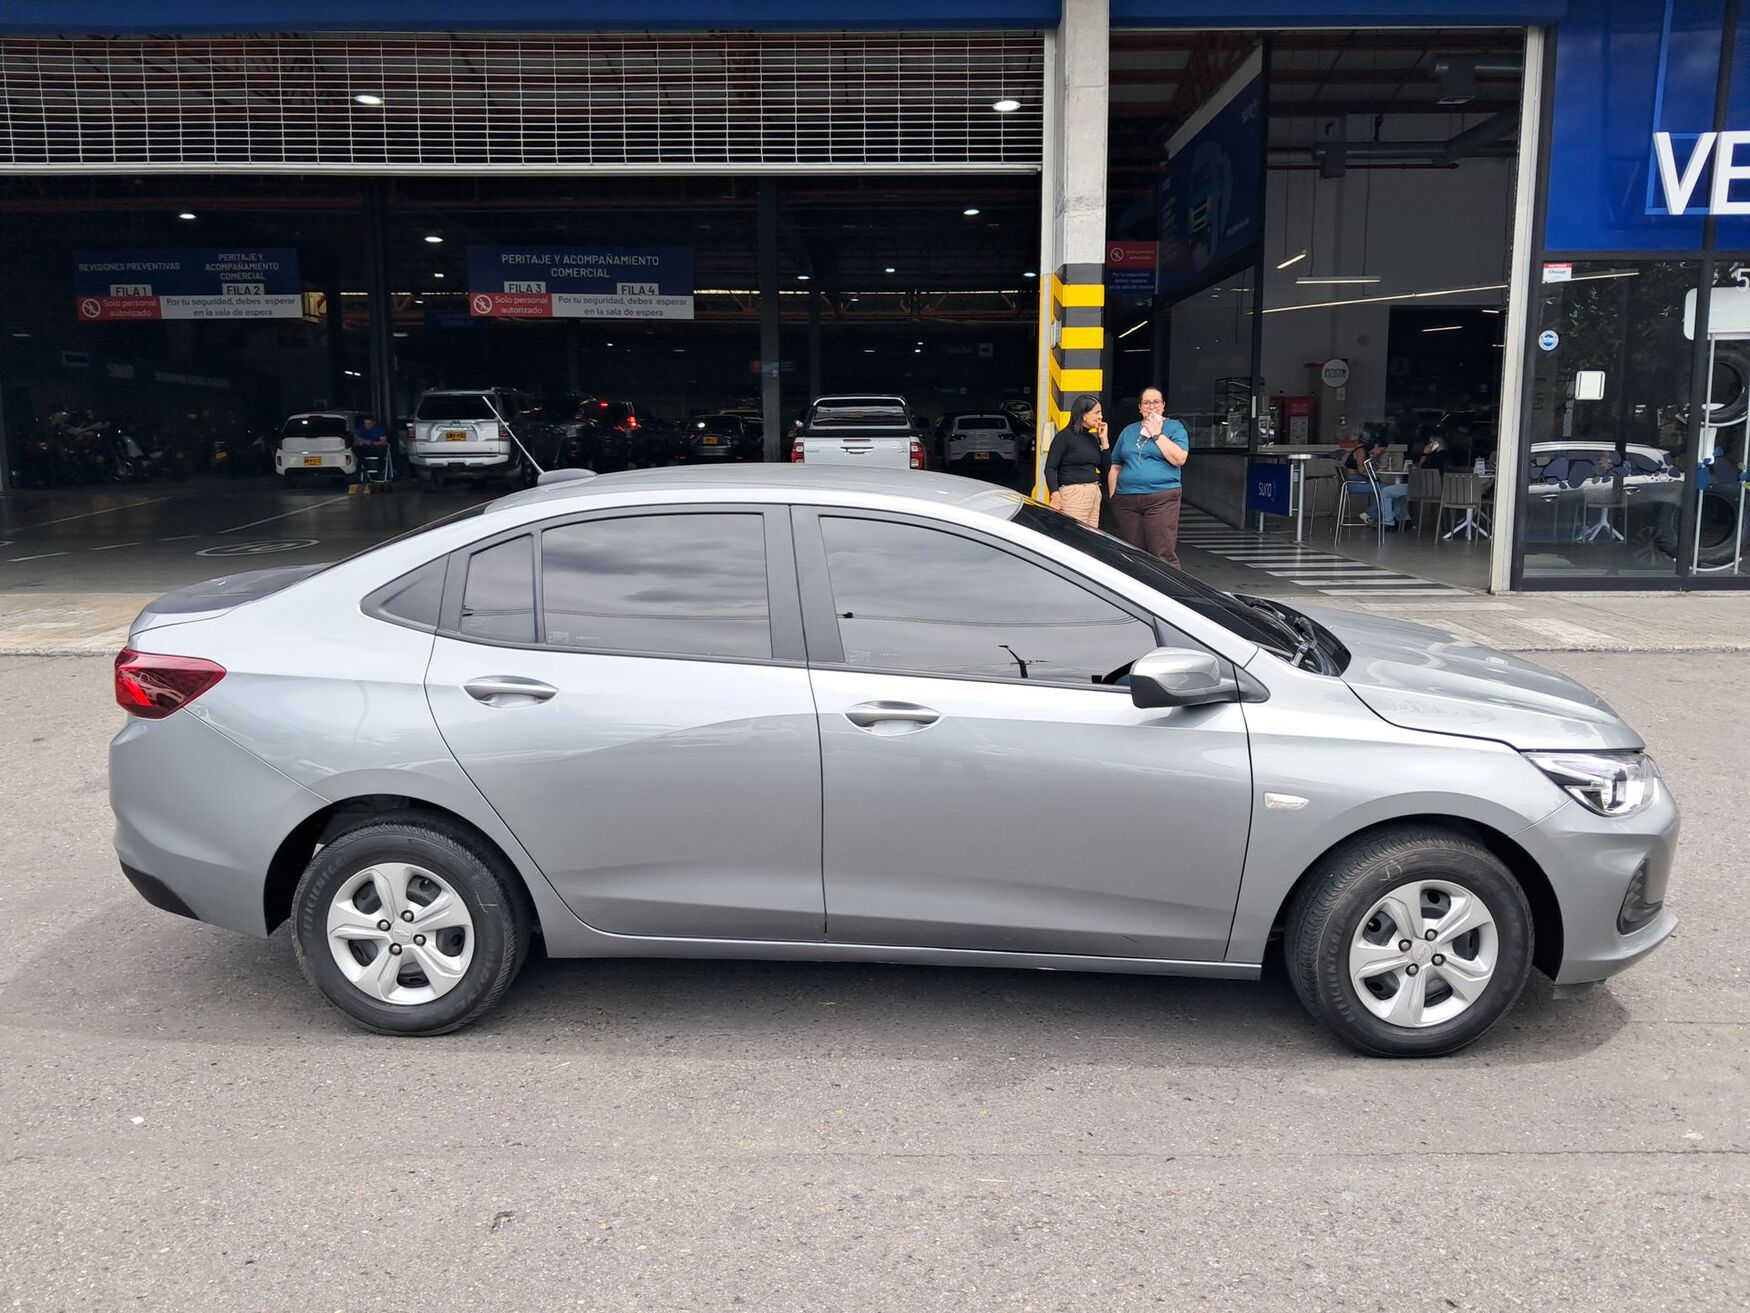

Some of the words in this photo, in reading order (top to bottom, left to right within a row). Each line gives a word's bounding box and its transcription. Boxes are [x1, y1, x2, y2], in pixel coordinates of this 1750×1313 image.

[1652, 130, 1750, 215] VE
[218, 253, 256, 262] PERITAJE
[258, 253, 263, 261] Y
[501, 254, 552, 264] PERITAJE
[554, 254, 561, 264] Y
[563, 253, 659, 266] ACOMPAÑAMIENTO
[79, 263, 125, 272] REVISIONES
[126, 262, 180, 271] PREVENTIVAS
[205, 261, 279, 271] ACOMPAÑAMIENTO
[220, 272, 266, 280] COMERCIAL
[551, 268, 611, 278] COMERCIAL
[116, 287, 140, 296] FILA
[227, 286, 251, 295] FILA
[254, 286, 260, 295] 2
[508, 284, 533, 293] FILA
[536, 284, 542, 293] 3
[621, 285, 647, 295] FILA
[648, 286, 655, 295] 4
[514, 296, 549, 304] personal
[558, 296, 572, 304] Por
[573, 296, 582, 304] tu
[627, 297, 653, 305] debes
[656, 299, 687, 307] esperar
[623, 308, 634, 316] de
[636, 309, 663, 317] espera
